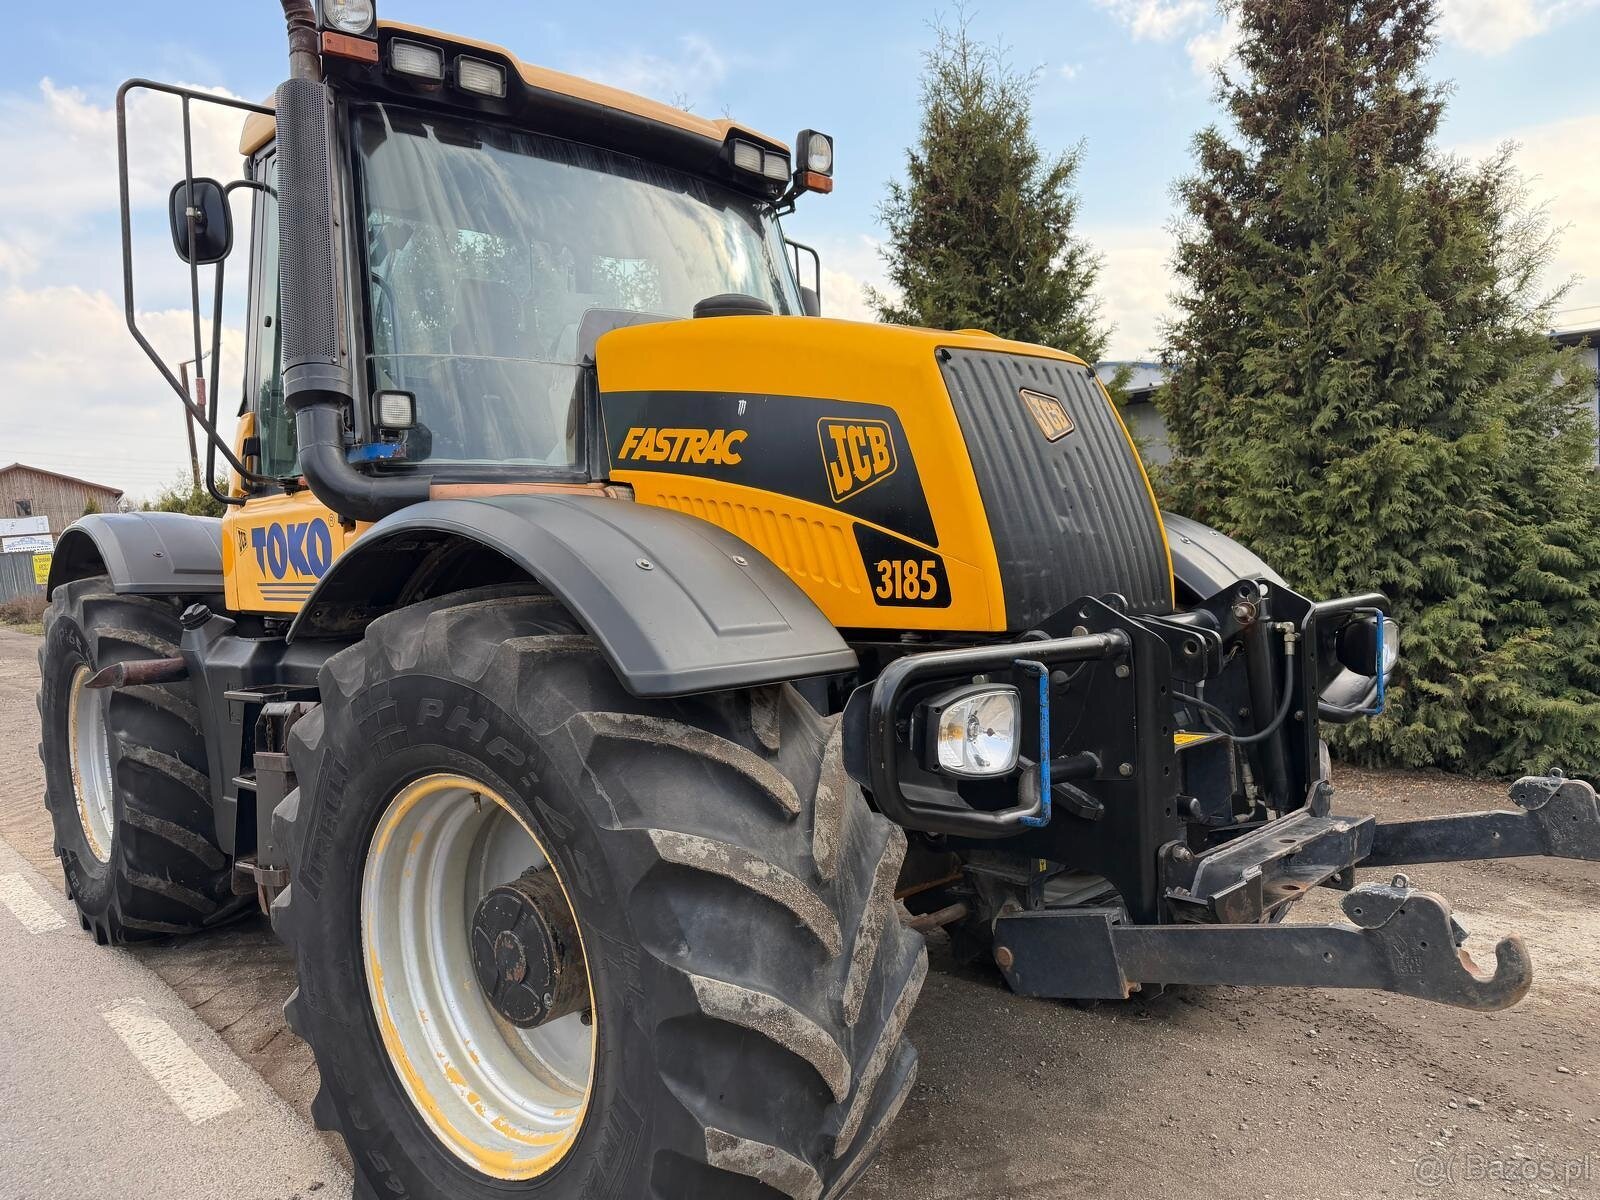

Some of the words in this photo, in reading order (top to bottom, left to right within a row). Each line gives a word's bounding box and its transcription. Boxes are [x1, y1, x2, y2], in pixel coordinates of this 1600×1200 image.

[617, 427, 749, 466] FASTRAC
[828, 424, 890, 496] JCB
[251, 517, 332, 580] TOKO
[875, 559, 938, 600] 3185
